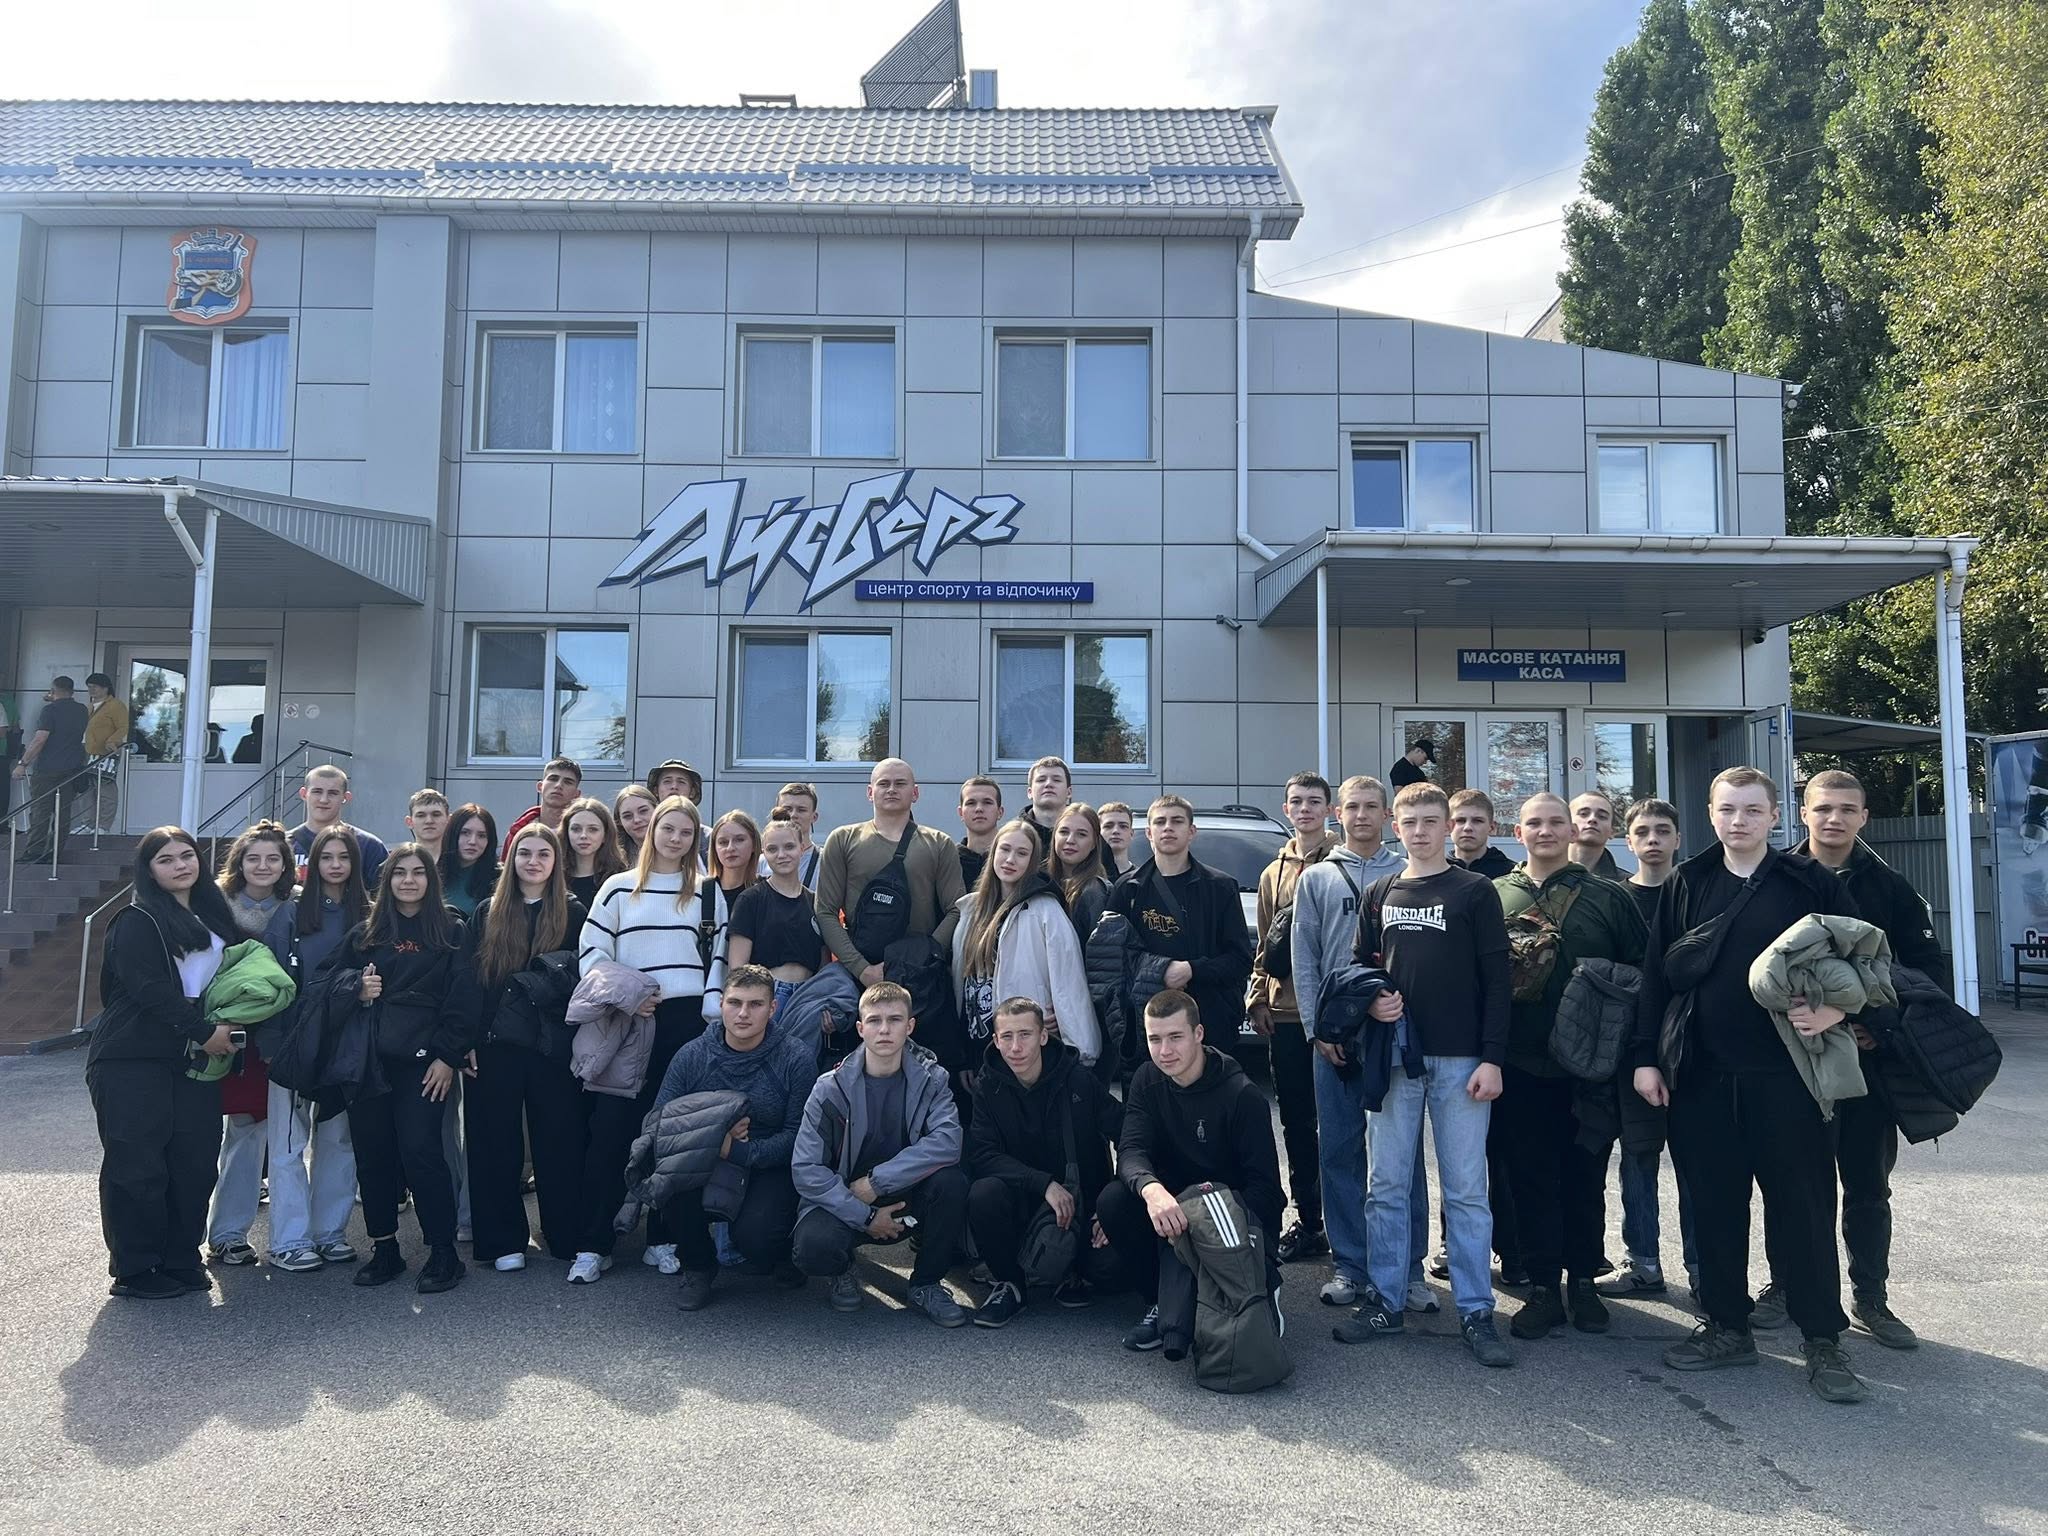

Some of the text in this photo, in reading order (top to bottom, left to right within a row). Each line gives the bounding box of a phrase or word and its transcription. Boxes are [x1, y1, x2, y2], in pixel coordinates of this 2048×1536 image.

[868, 582, 1080, 599] центр спорту та відпочинку
[1463, 652, 1620, 665] МАСОВЕ КАТАННЯ
[1519, 667, 1565, 679] КАСА
[1382, 904, 1444, 926] LONSDALE
